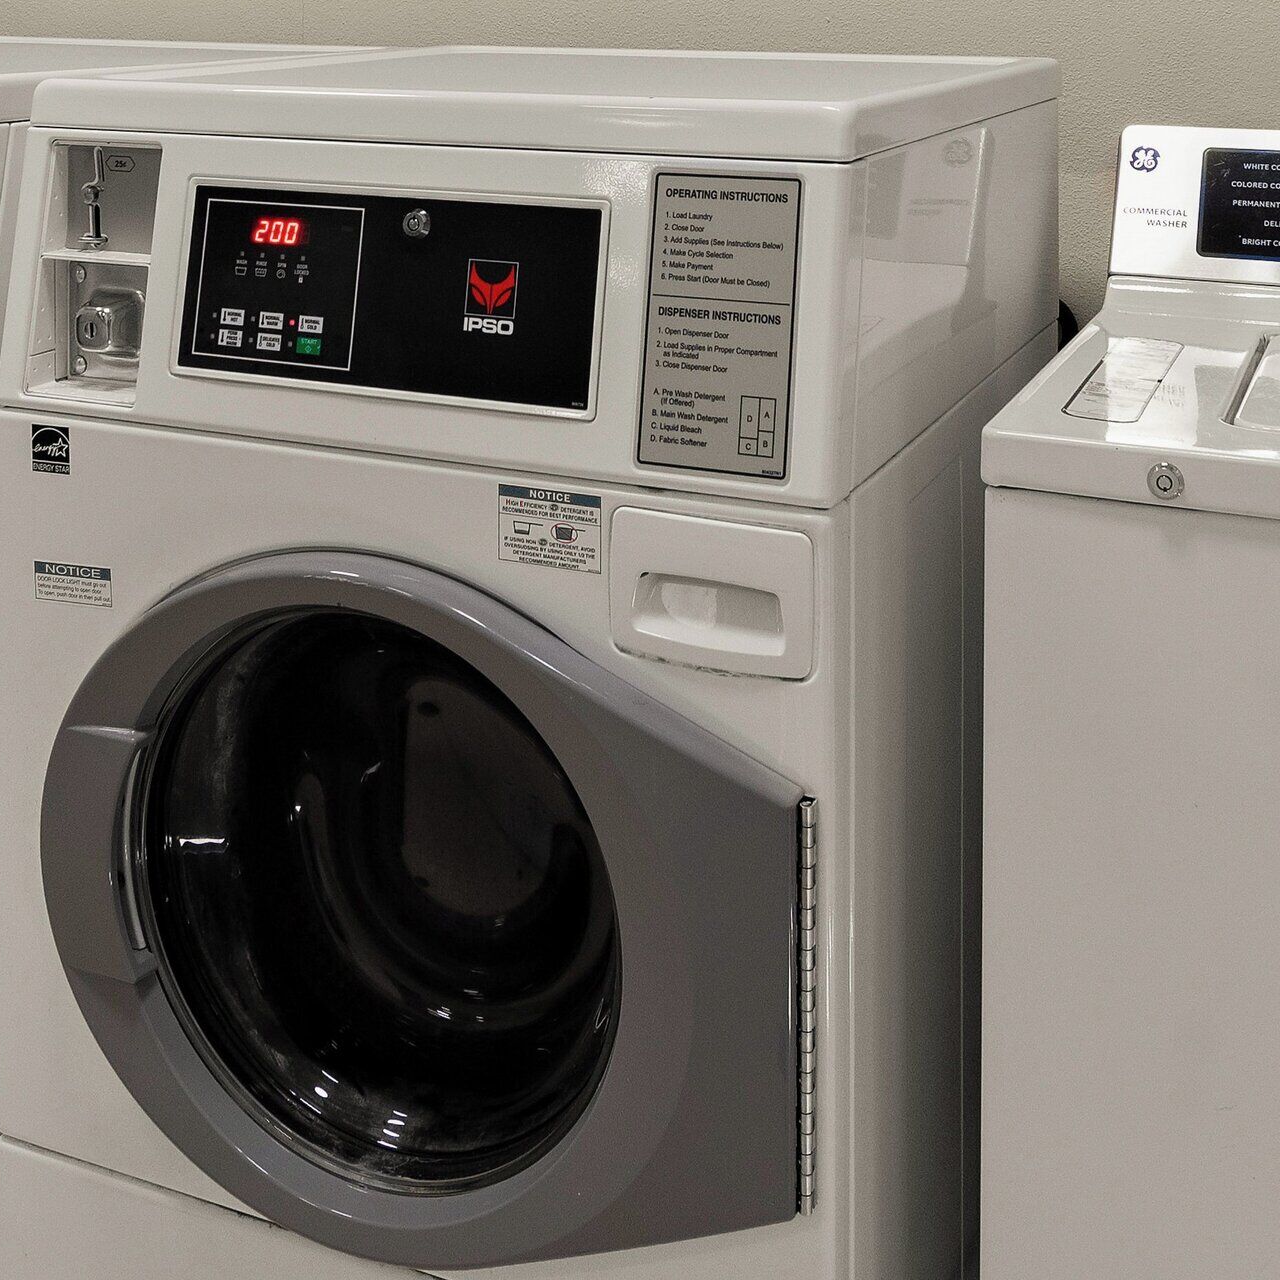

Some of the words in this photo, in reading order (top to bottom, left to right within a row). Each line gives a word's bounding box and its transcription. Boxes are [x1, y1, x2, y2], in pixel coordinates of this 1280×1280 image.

[666, 188, 717, 199] OPERATING
[720, 191, 788, 203] INSTRUCTIONS
[1232, 200, 1280, 208] PERMANENT
[689, 213, 712, 221] Laundry
[1123, 207, 1188, 217] COMMERCIAL
[672, 224, 688, 232] Close
[1147, 220, 1188, 228] WASHER
[255, 221, 298, 243] 200
[684, 238, 709, 246] Supplies
[711, 239, 724, 247] (See
[726, 240, 760, 248] Instructions
[762, 242, 783, 250] Below)
[1242, 238, 1271, 246] BRIGHT
[688, 250, 704, 258] Cycle
[687, 263, 713, 271] Payment
[702, 276, 719, 284] (Door
[721, 277, 735, 285] Must
[747, 279, 770, 288] Closed)
[658, 307, 709, 319] DISPENSER
[712, 312, 781, 325] INSTRUCTIONS
[463, 317, 514, 335] IPSO
[665, 328, 681, 336] Open
[683, 329, 712, 338] Dispenser
[714, 331, 729, 339] Door
[672, 351, 699, 359] Indicated
[680, 343, 705, 352] Supplies
[714, 345, 734, 355] Proper
[736, 348, 778, 358] Compartment
[663, 361, 680, 369] Close
[681, 363, 711, 372] Dispenser
[713, 365, 728, 373] Door
[662, 389, 673, 397] Pre
[675, 390, 692, 398] Wash
[694, 392, 725, 402] Detergent
[697, 413, 728, 424] Detergent
[660, 423, 679, 432] Liquid
[680, 425, 702, 434] Bleach
[659, 436, 679, 444] Fabric
[681, 438, 707, 447] Softener
[33, 463, 54, 471] ENERGY
[530, 490, 570, 502] NOTICE
[561, 507, 588, 515] DETERGENT
[45, 564, 101, 578] NOTICE
